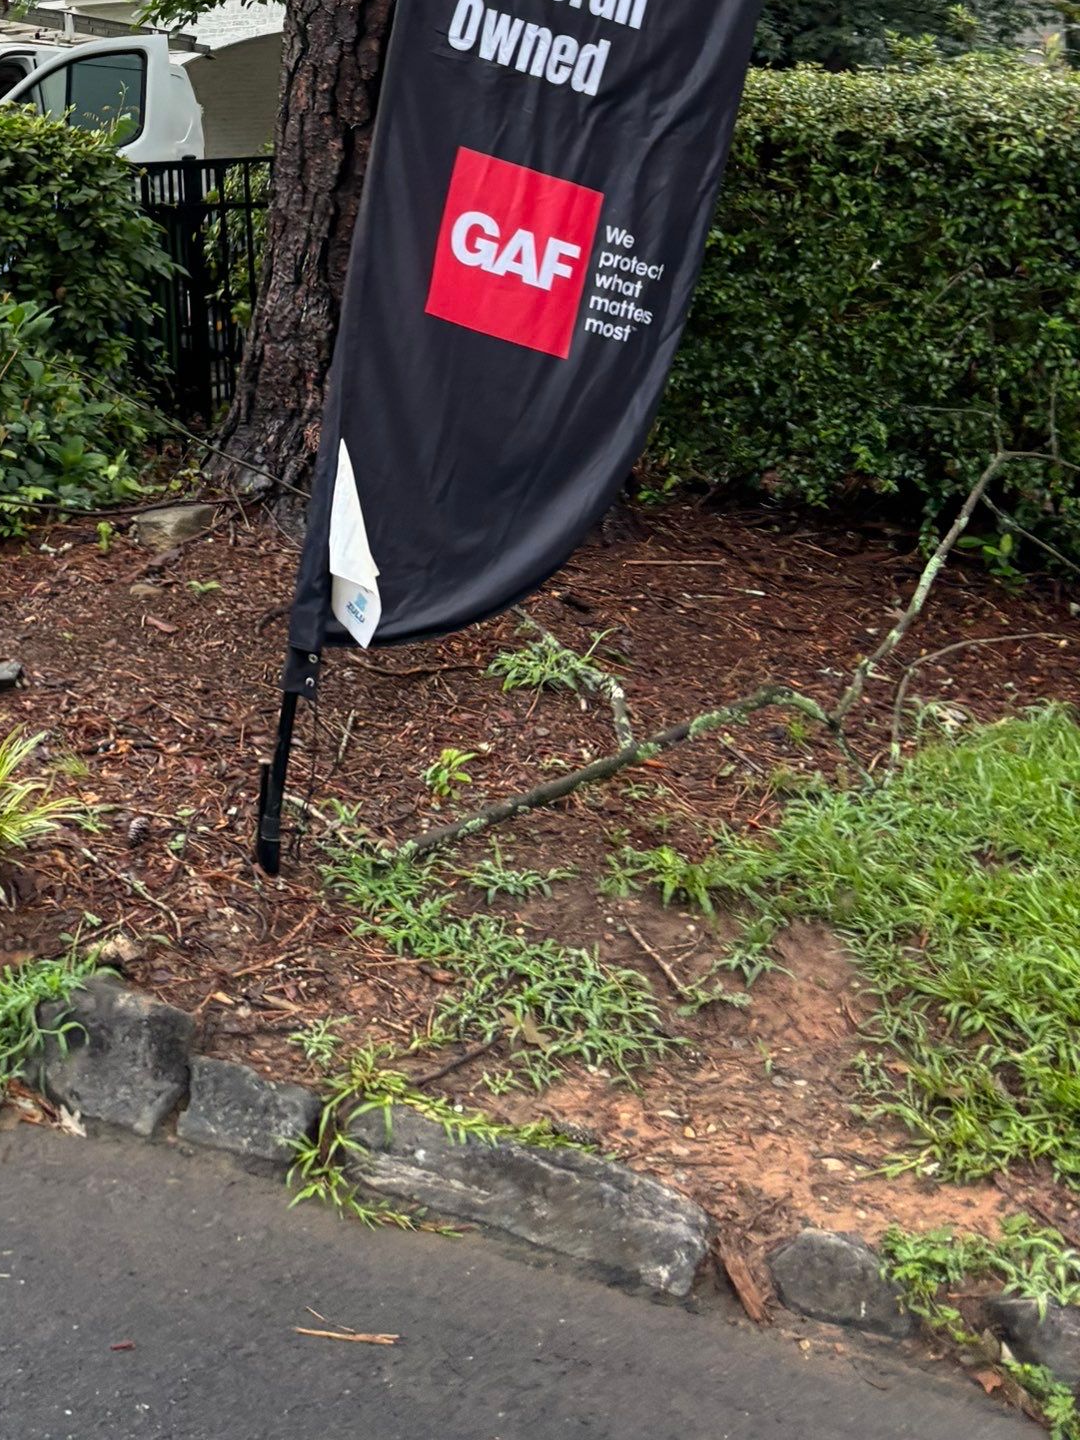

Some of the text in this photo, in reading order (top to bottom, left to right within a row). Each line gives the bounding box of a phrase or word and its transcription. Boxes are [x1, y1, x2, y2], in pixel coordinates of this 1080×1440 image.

[605, 225, 635, 248] We
[451, 211, 581, 291] GAF
[599, 251, 664, 280] protect
[596, 273, 643, 298] what
[584, 317, 632, 342] most
